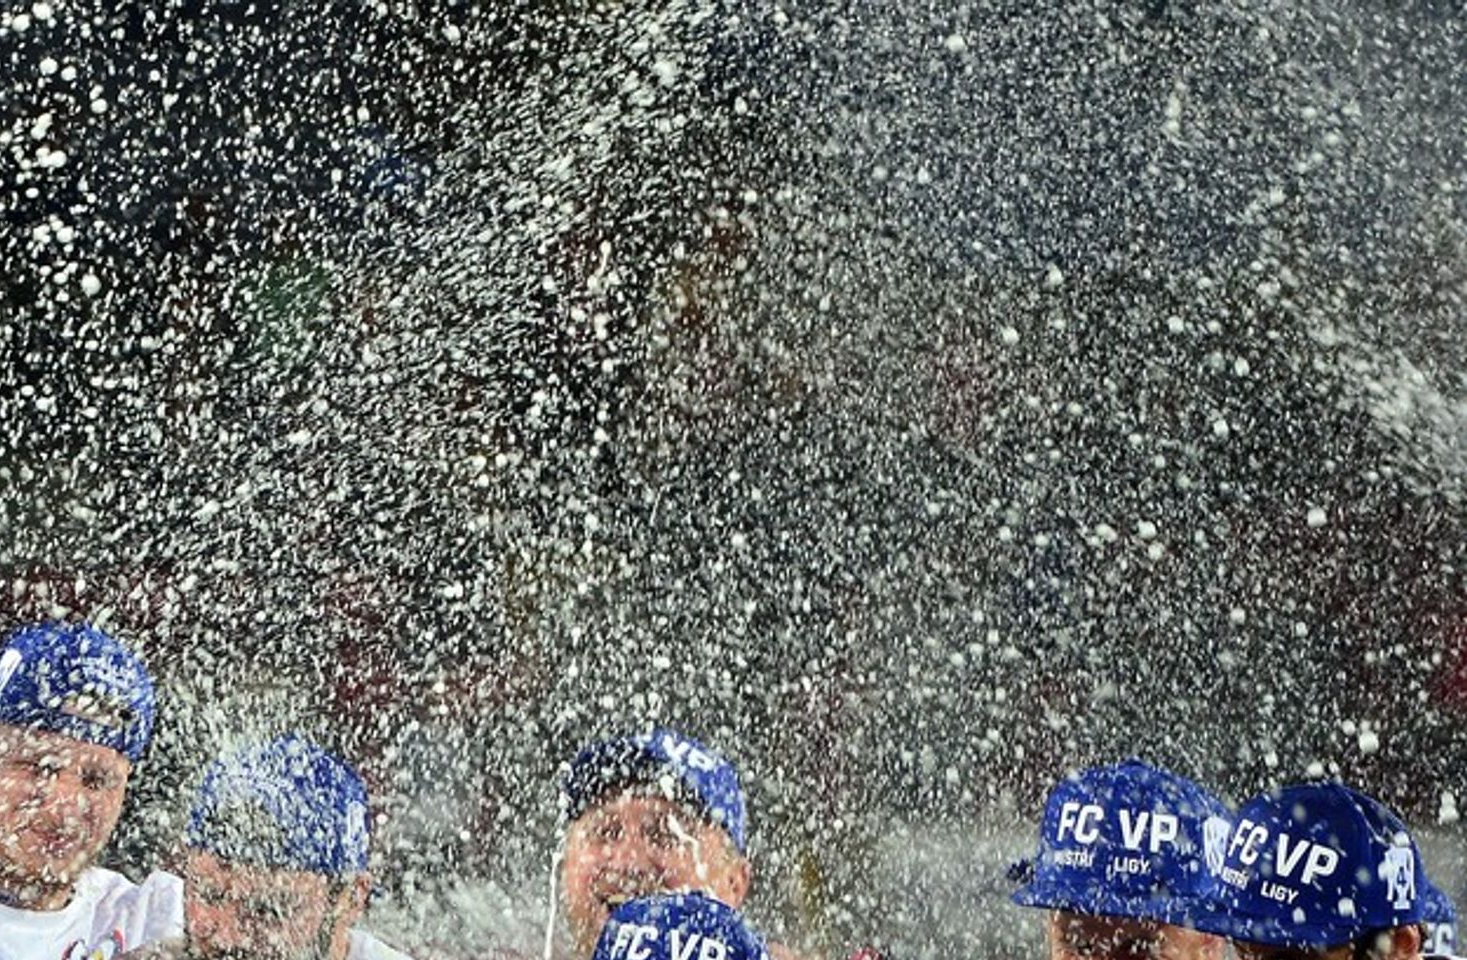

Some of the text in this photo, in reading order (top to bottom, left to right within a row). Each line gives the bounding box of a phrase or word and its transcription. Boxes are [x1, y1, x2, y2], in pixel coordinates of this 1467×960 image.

[1057, 802, 1179, 853] FC VP
[1113, 857, 1151, 875] LIGY
[1227, 818, 1339, 884] FC VP
[1260, 881, 1300, 904] LIGY
